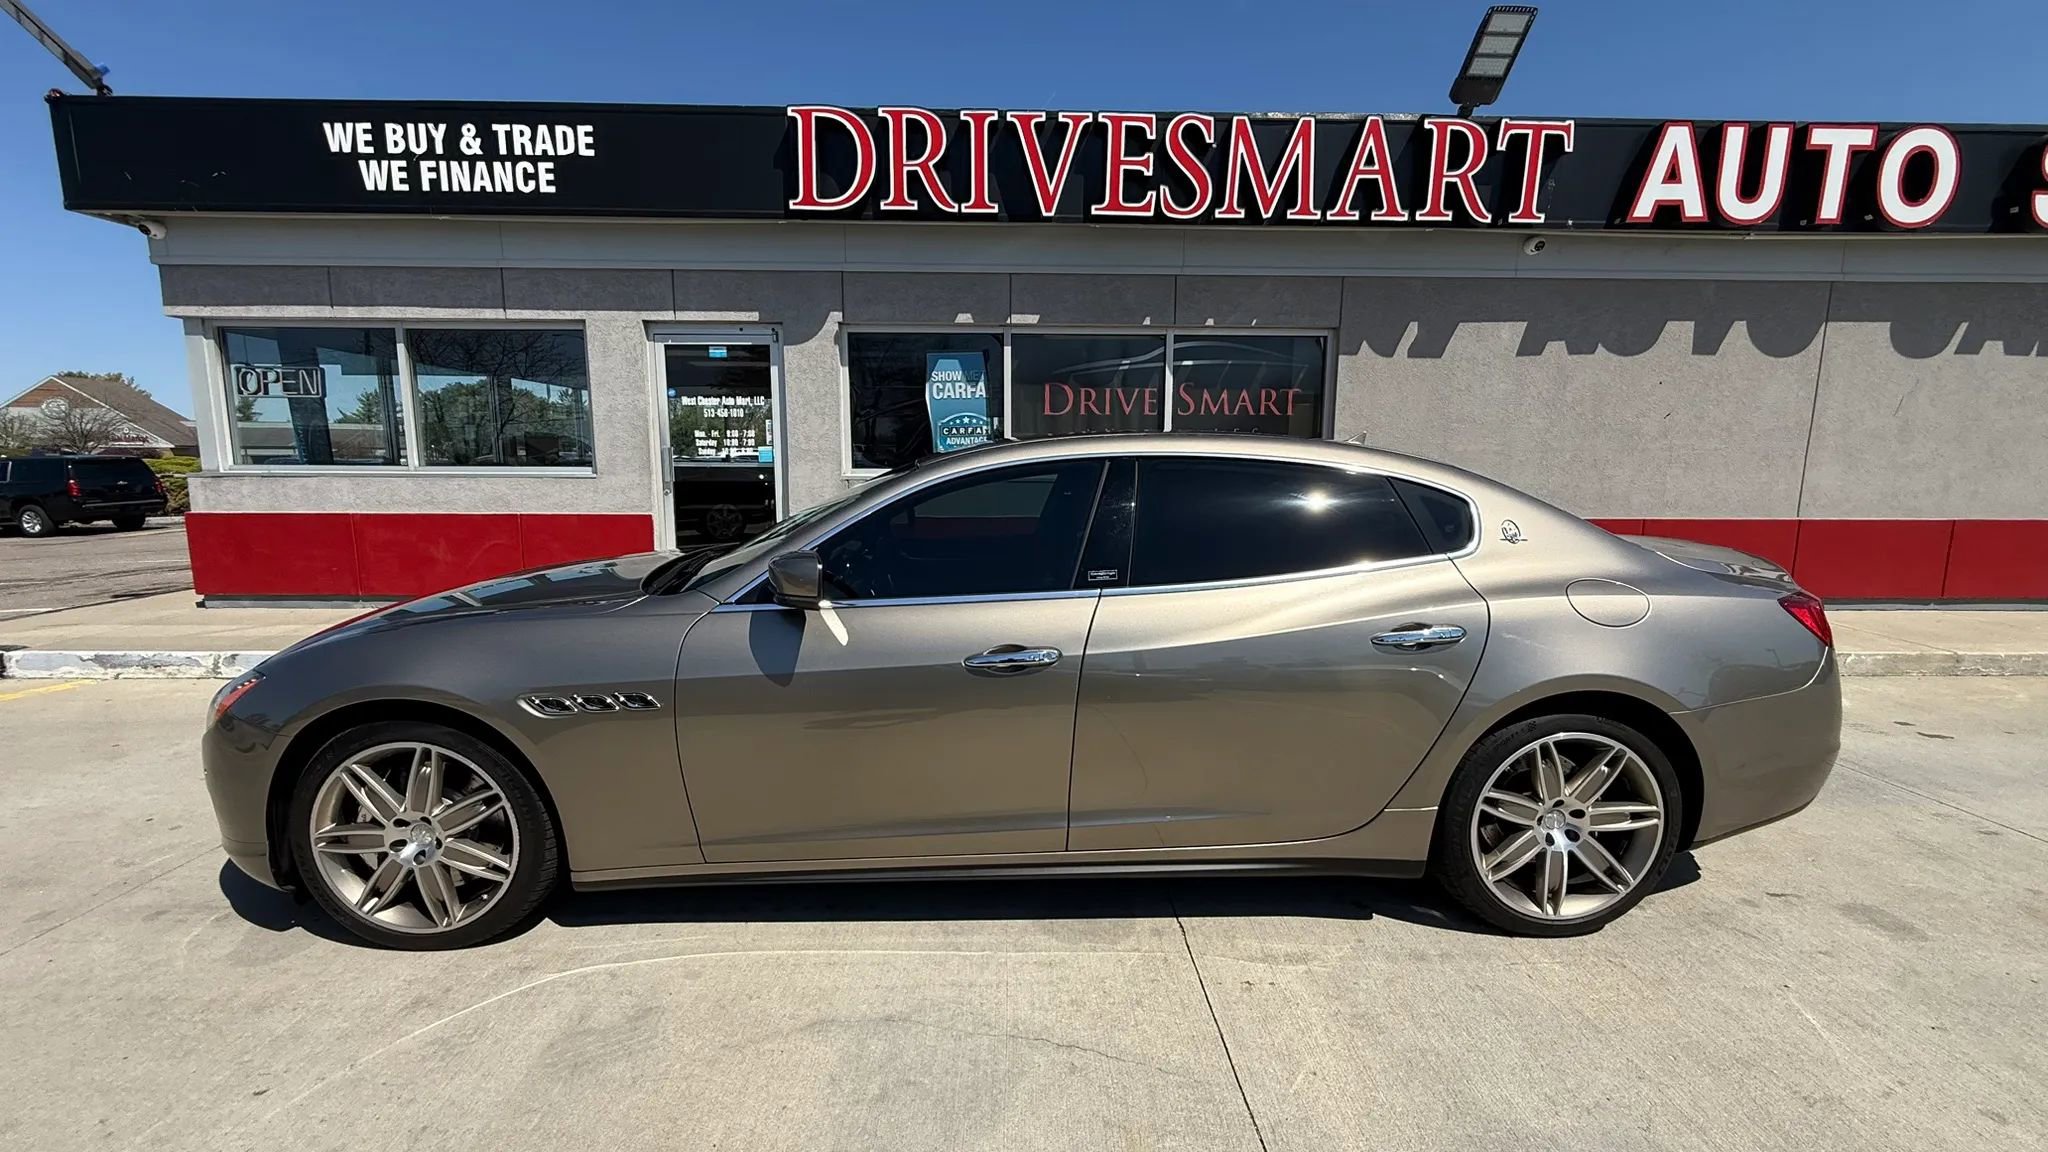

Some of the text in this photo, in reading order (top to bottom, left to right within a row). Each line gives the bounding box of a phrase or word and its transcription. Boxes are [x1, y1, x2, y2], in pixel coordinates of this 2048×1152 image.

[323, 122, 595, 157] WE BUY & TRADE
[787, 104, 1574, 223] DRIVESMART
[358, 160, 556, 193] WE FINANCE
[1626, 121, 1963, 229] AUTO
[239, 368, 317, 396] OPEN
[931, 371, 963, 381] SHOW
[681, 396, 696, 406] West
[697, 396, 721, 406] Chester
[721, 396, 735, 406] Auto
[754, 396, 765, 406] LLC
[932, 382, 986, 399] CARFA
[695, 439, 718, 447] Saturday
[946, 436, 987, 445] ADVANTAGE
